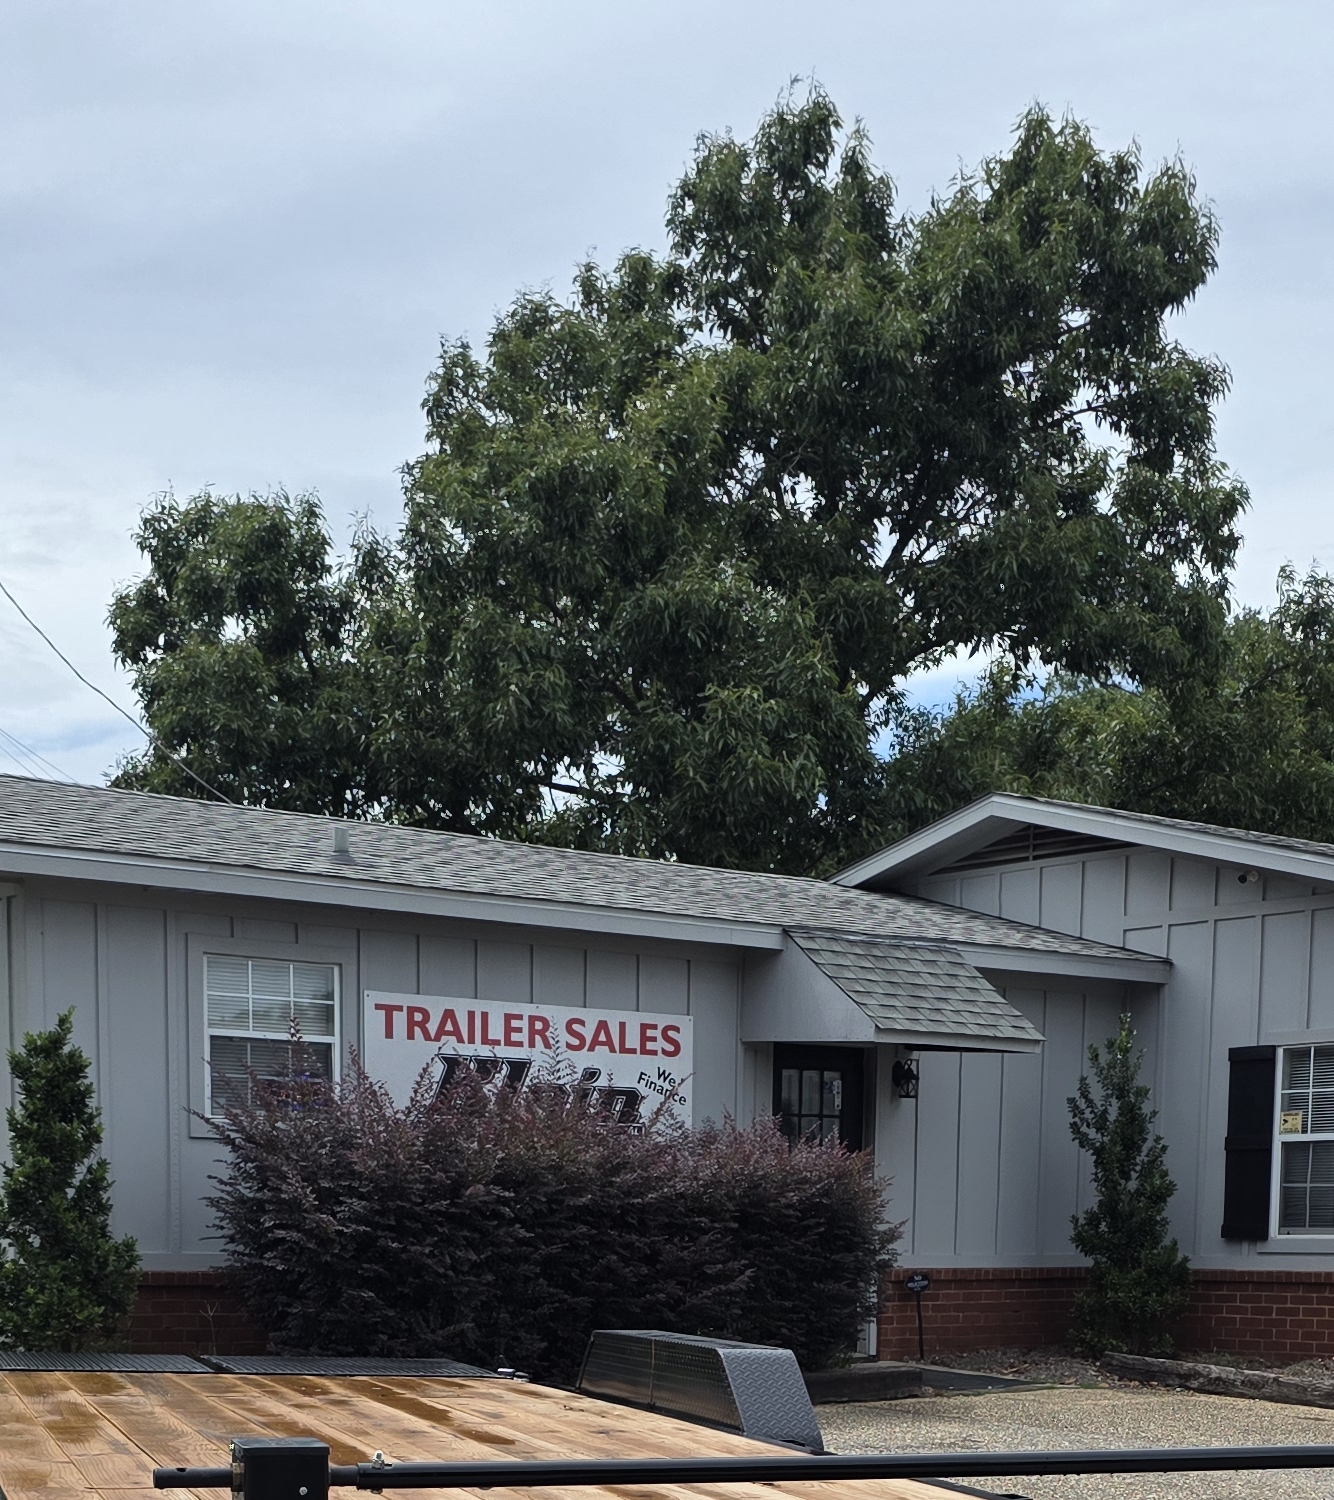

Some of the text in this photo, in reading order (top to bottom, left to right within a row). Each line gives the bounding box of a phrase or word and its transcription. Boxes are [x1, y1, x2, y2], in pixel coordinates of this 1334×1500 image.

[374, 1003, 682, 1058] TRAILER SALES
[637, 1071, 687, 1106] Finance
[657, 1066, 676, 1087] We
